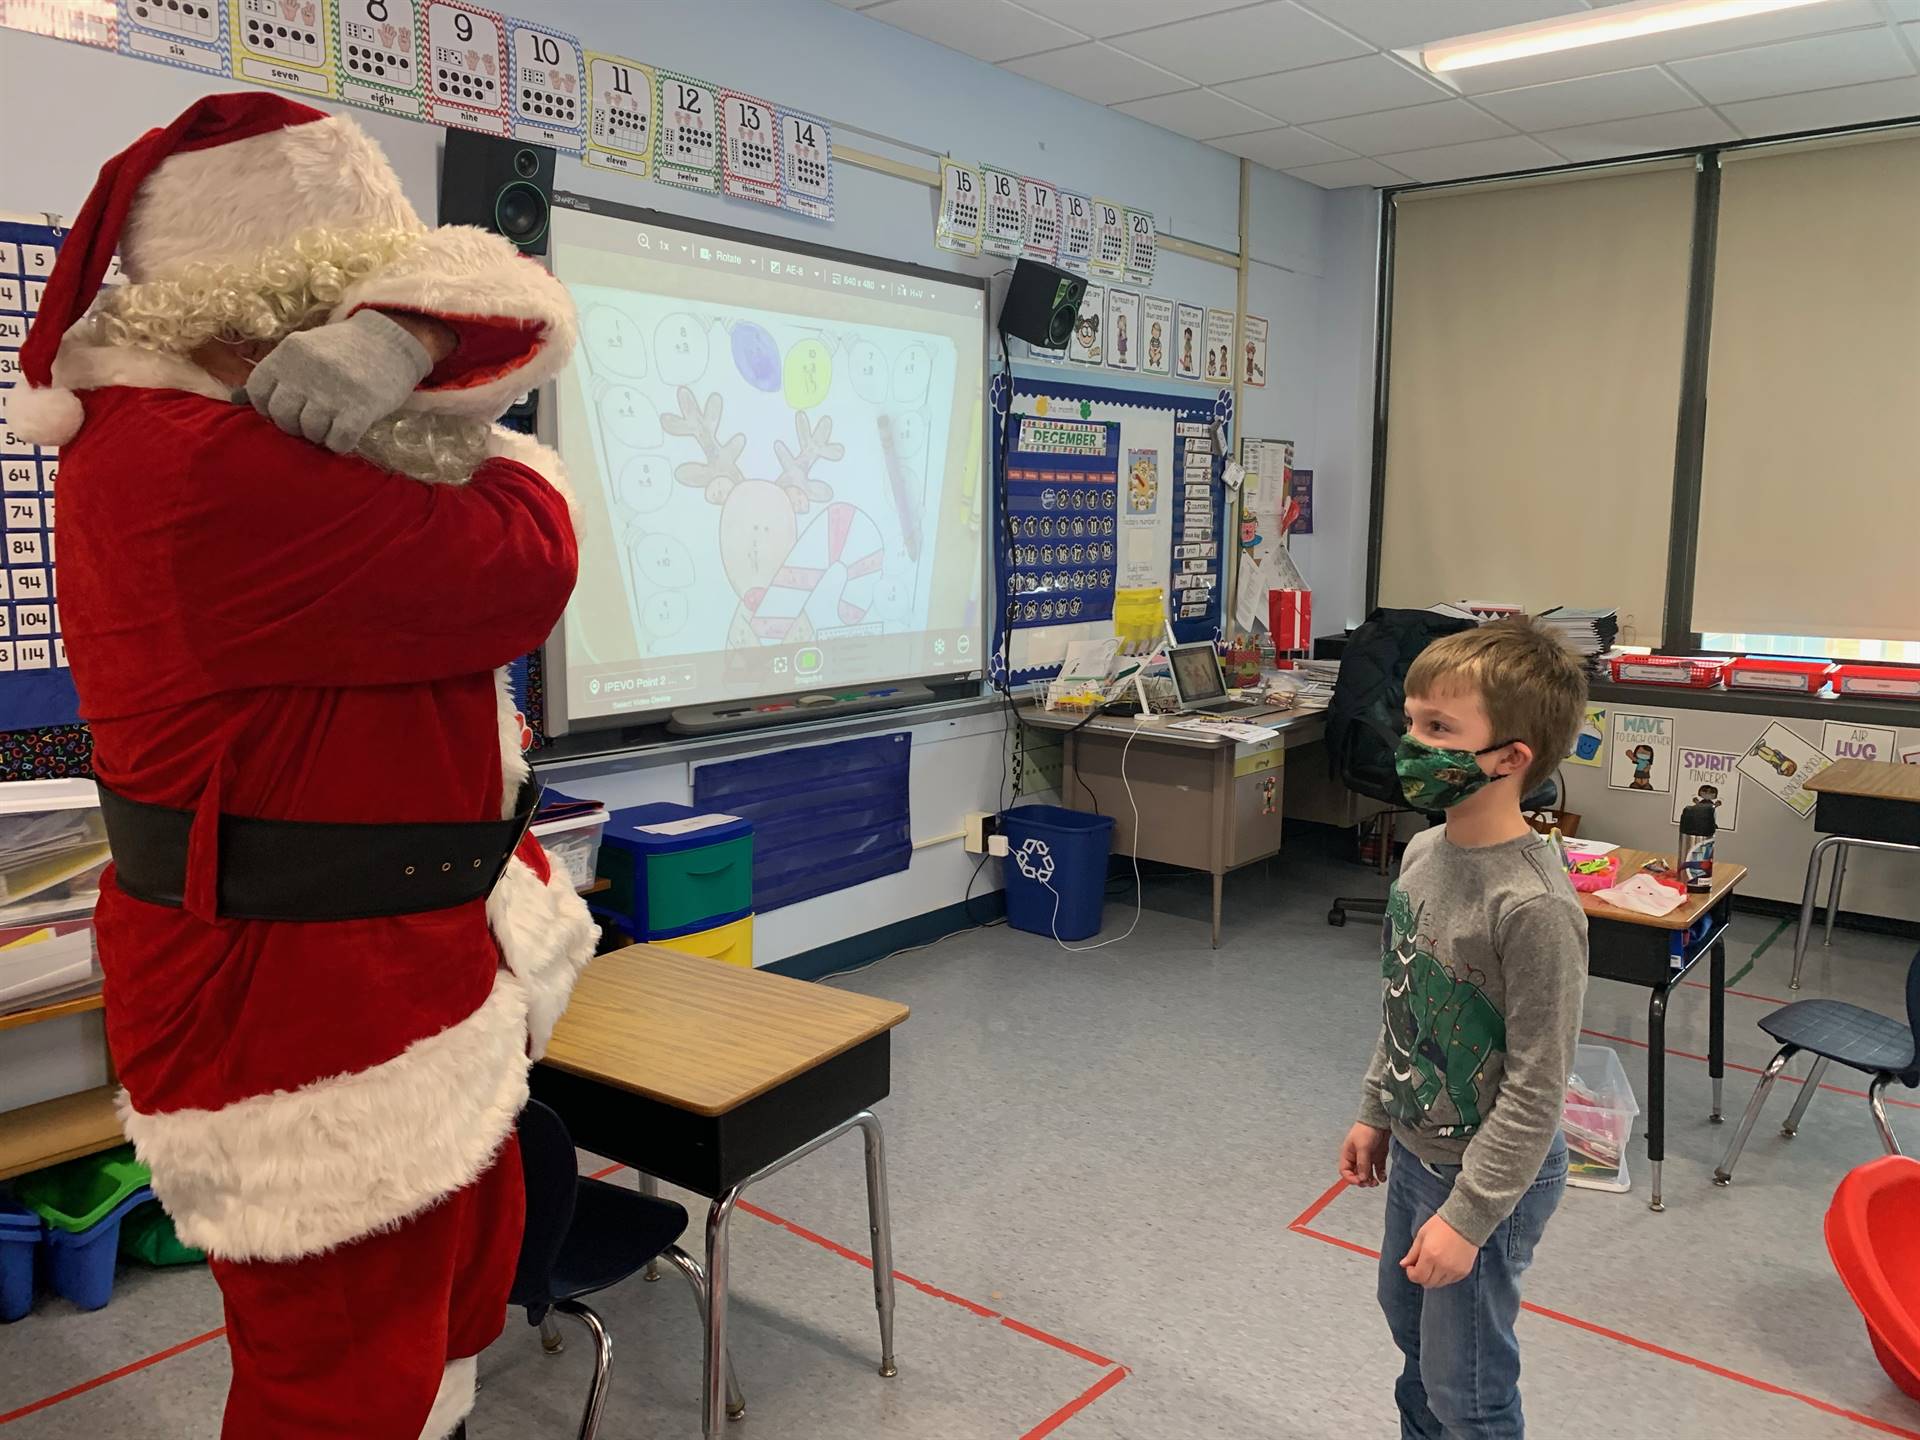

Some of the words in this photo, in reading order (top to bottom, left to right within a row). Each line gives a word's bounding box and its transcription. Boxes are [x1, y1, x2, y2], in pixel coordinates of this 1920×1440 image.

[454, 14, 473, 41] 9
[169, 46, 185, 57] six
[532, 36, 560, 65] 10
[271, 69, 299, 83] seven
[612, 66, 632, 95] 11
[370, 92, 395, 107] eight
[677, 85, 702, 114] 12
[461, 112, 478, 123] nine
[739, 104, 760, 130] 13
[543, 130, 555, 140] ten
[794, 121, 816, 147] 14
[606, 155, 628, 168] eleven
[677, 171, 699, 183] twelve
[956, 170, 972, 192] 15
[742, 182, 766, 196] thirteen
[994, 175, 1011, 196] 16
[1034, 187, 1047, 206] 17
[1068, 197, 1083, 217] 18
[1103, 207, 1116, 226] 19
[1133, 216, 1149, 234] 20
[658, 240, 670, 251] 1x
[34, 253, 45, 266] 5
[716, 250, 742, 265] Rotate
[112, 263, 121, 276] 7
[862, 279, 875, 290] 480
[0, 324, 20, 338] 24
[1, 359, 22, 373] 34
[1033, 429, 1097, 447] DECEMBER
[9, 468, 31, 482] 64
[1060, 497, 1066, 507] 2
[1075, 497, 1081, 507] 3
[1089, 496, 1095, 508] 4
[1105, 497, 1113, 507] 5
[10, 505, 34, 519] 74
[1012, 522, 1018, 533] 6
[1029, 521, 1034, 534] 7
[1044, 522, 1050, 534] 8
[1060, 522, 1066, 534] 9
[1075, 522, 1083, 534] 10
[1090, 522, 1097, 534] 11
[1104, 521, 1112, 533] 12
[13, 540, 36, 555] 84
[1089, 547, 1098, 561] 18
[1104, 546, 1111, 557] 19
[1027, 550, 1035, 563] 14
[1044, 550, 1052, 562] 15
[1059, 549, 1068, 562] 16
[1074, 549, 1082, 562] 17
[19, 575, 42, 590] 94
[1059, 577, 1069, 587] 23
[1075, 577, 1085, 588] 24
[1088, 575, 1096, 586] 25
[20, 612, 47, 626] 104
[22, 647, 45, 660] 114
[604, 679, 634, 693] IPEVO
[636, 676, 659, 689] Point
[659, 675, 666, 686] 2
[1623, 716, 1665, 735] WAVE
[1615, 731, 1625, 742] TO
[1626, 733, 1646, 744] EACH
[1648, 734, 1671, 746] OTHER
[1850, 729, 1869, 742] AIR
[1835, 739, 1877, 761] HUG
[1684, 751, 1736, 773] SPIRIT
[1689, 769, 1728, 785] FINGERS
